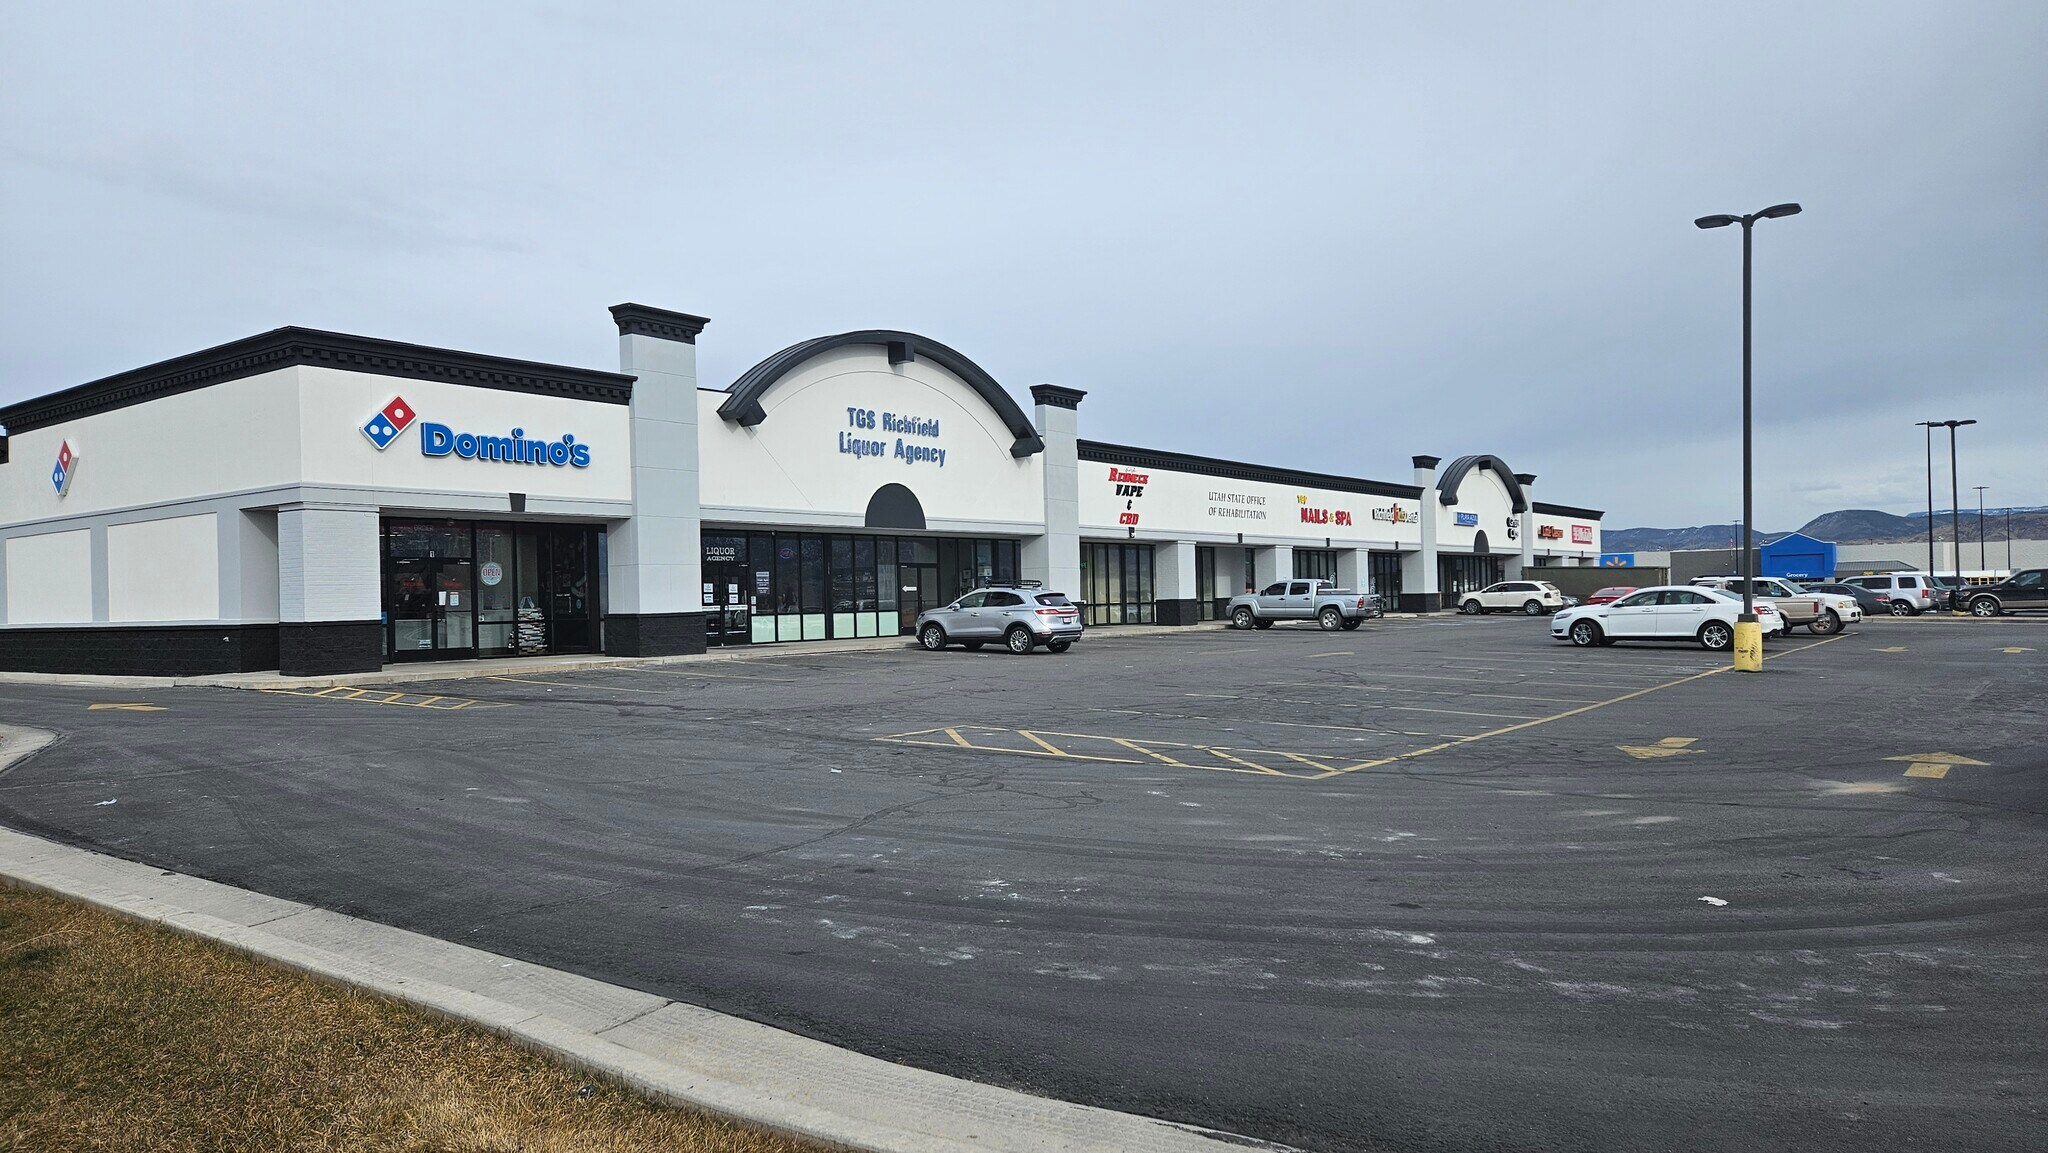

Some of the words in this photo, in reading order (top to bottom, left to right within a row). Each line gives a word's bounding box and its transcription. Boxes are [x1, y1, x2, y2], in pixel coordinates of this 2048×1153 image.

[847, 407, 876, 430] TGS
[882, 412, 940, 438] Richfield
[421, 421, 590, 468] Domino's
[839, 432, 886, 459] Liquor
[894, 438, 946, 468] Agency
[1115, 484, 1144, 497] VAPE
[1208, 491, 1226, 502] UTAH
[1227, 493, 1245, 504] STATE
[1246, 495, 1266, 506] OFFICE
[1119, 512, 1139, 525] CBD
[1208, 506, 1217, 516] OF
[1218, 507, 1267, 520] REHABILITATION
[1301, 507, 1328, 524] NAILS
[1335, 510, 1352, 526] SPA
[706, 547, 735, 555] LIQUOR
[482, 568, 501, 577] OPEN
